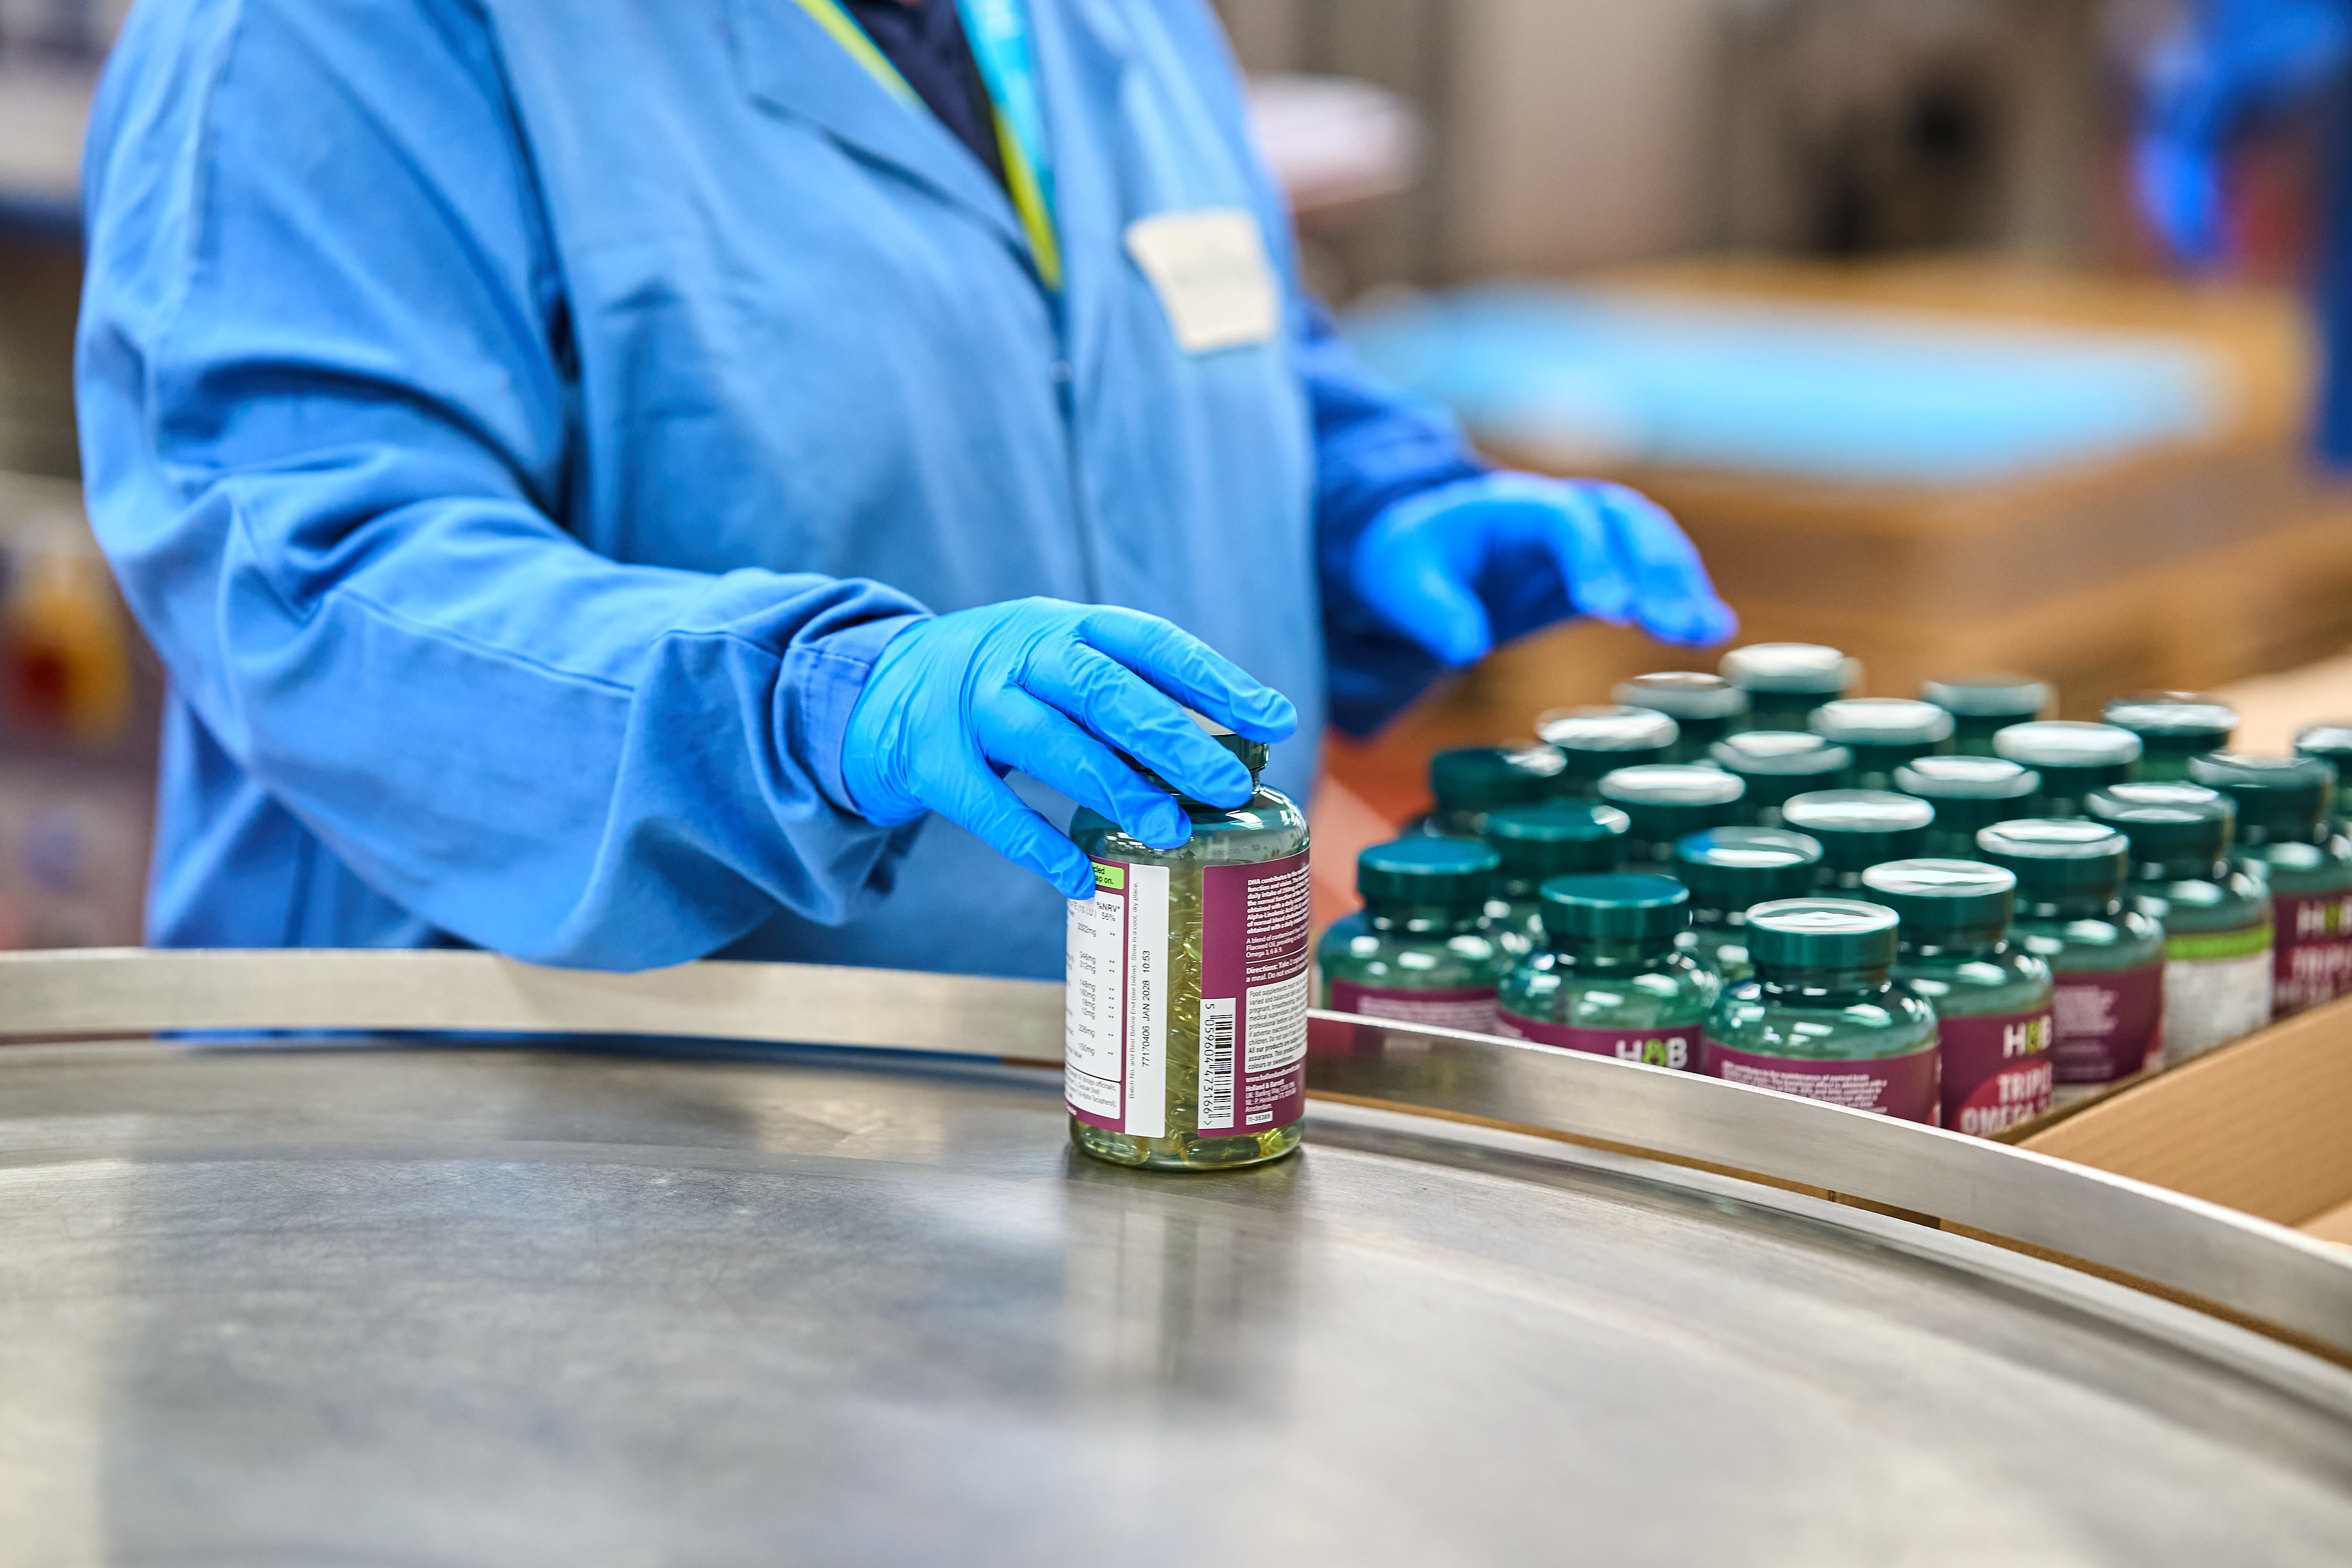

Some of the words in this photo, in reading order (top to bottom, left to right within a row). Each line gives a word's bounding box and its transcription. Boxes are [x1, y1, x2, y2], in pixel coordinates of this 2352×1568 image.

[1093, 866, 1105, 874] cled
[1247, 904, 1271, 913] obtained
[1246, 925, 1271, 934] obtained
[1246, 942, 1268, 950] Flaxseed
[1246, 964, 1278, 974] Directions:
[1251, 973, 1267, 981] meal.
[1249, 1005, 1271, 1014] pregnant,
[1248, 1021, 1275, 1030] professional
[1204, 1019, 1215, 1063] 059604
[1248, 1053, 1273, 1061] assurance.
[1204, 1070, 1213, 1114] 473166
